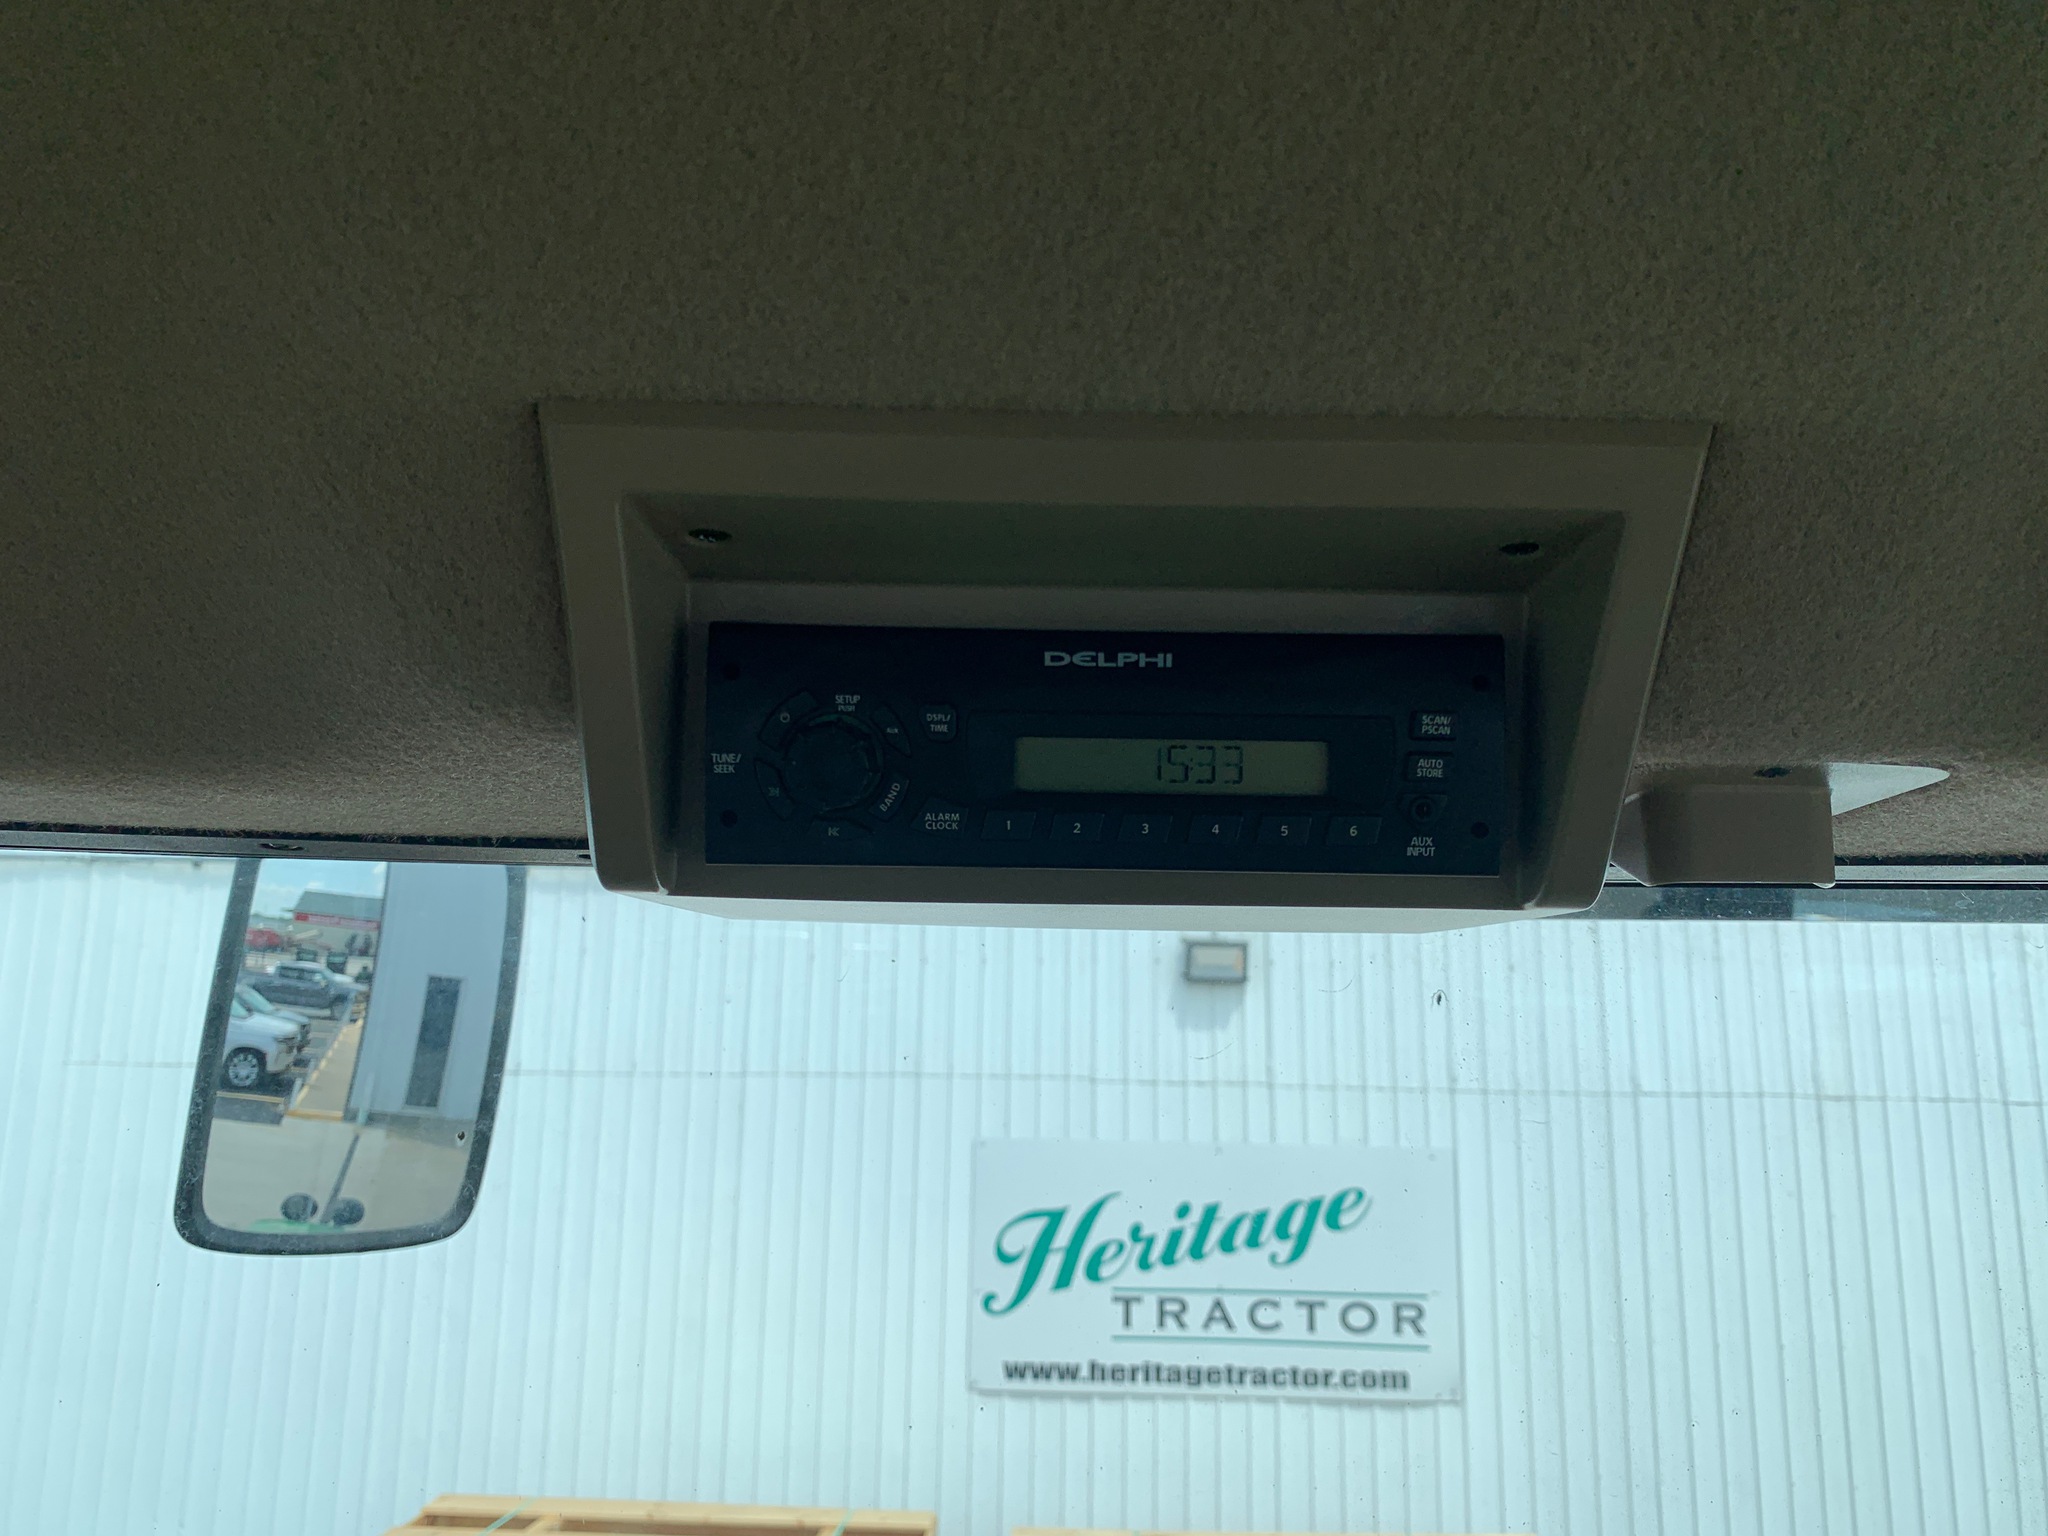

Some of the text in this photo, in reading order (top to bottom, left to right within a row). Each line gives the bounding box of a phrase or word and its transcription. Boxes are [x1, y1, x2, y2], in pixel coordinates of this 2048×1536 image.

[1044, 651, 1173, 668] DELPHI
[835, 695, 860, 704] SETUP
[1421, 715, 1452, 725] SCAN/
[929, 724, 949, 733] TIME
[1421, 725, 1450, 735] PSCAN
[710, 753, 742, 763] TUNE/
[1417, 758, 1444, 768] AUTO
[713, 764, 736, 774] SEEK
[1157, 745, 1244, 784] 15:33
[1416, 768, 1444, 778] STORE
[879, 782, 901, 812] BAND
[924, 813, 960, 822] ALARM
[925, 821, 959, 831] CLOCK
[1006, 820, 1011, 831] 1
[1072, 822, 1082, 834] 2
[1140, 823, 1150, 834] 3
[1211, 824, 1220, 835] 4
[1280, 825, 1289, 837] 5
[1349, 826, 1358, 837] 6
[1410, 836, 1434, 847] AUX
[1406, 847, 1436, 857] INPUT
[983, 1186, 1370, 1316] Heritage
[1113, 1296, 1427, 1336] TRACTOR
[1002, 1359, 1411, 1391] www.heritagetractor.com
